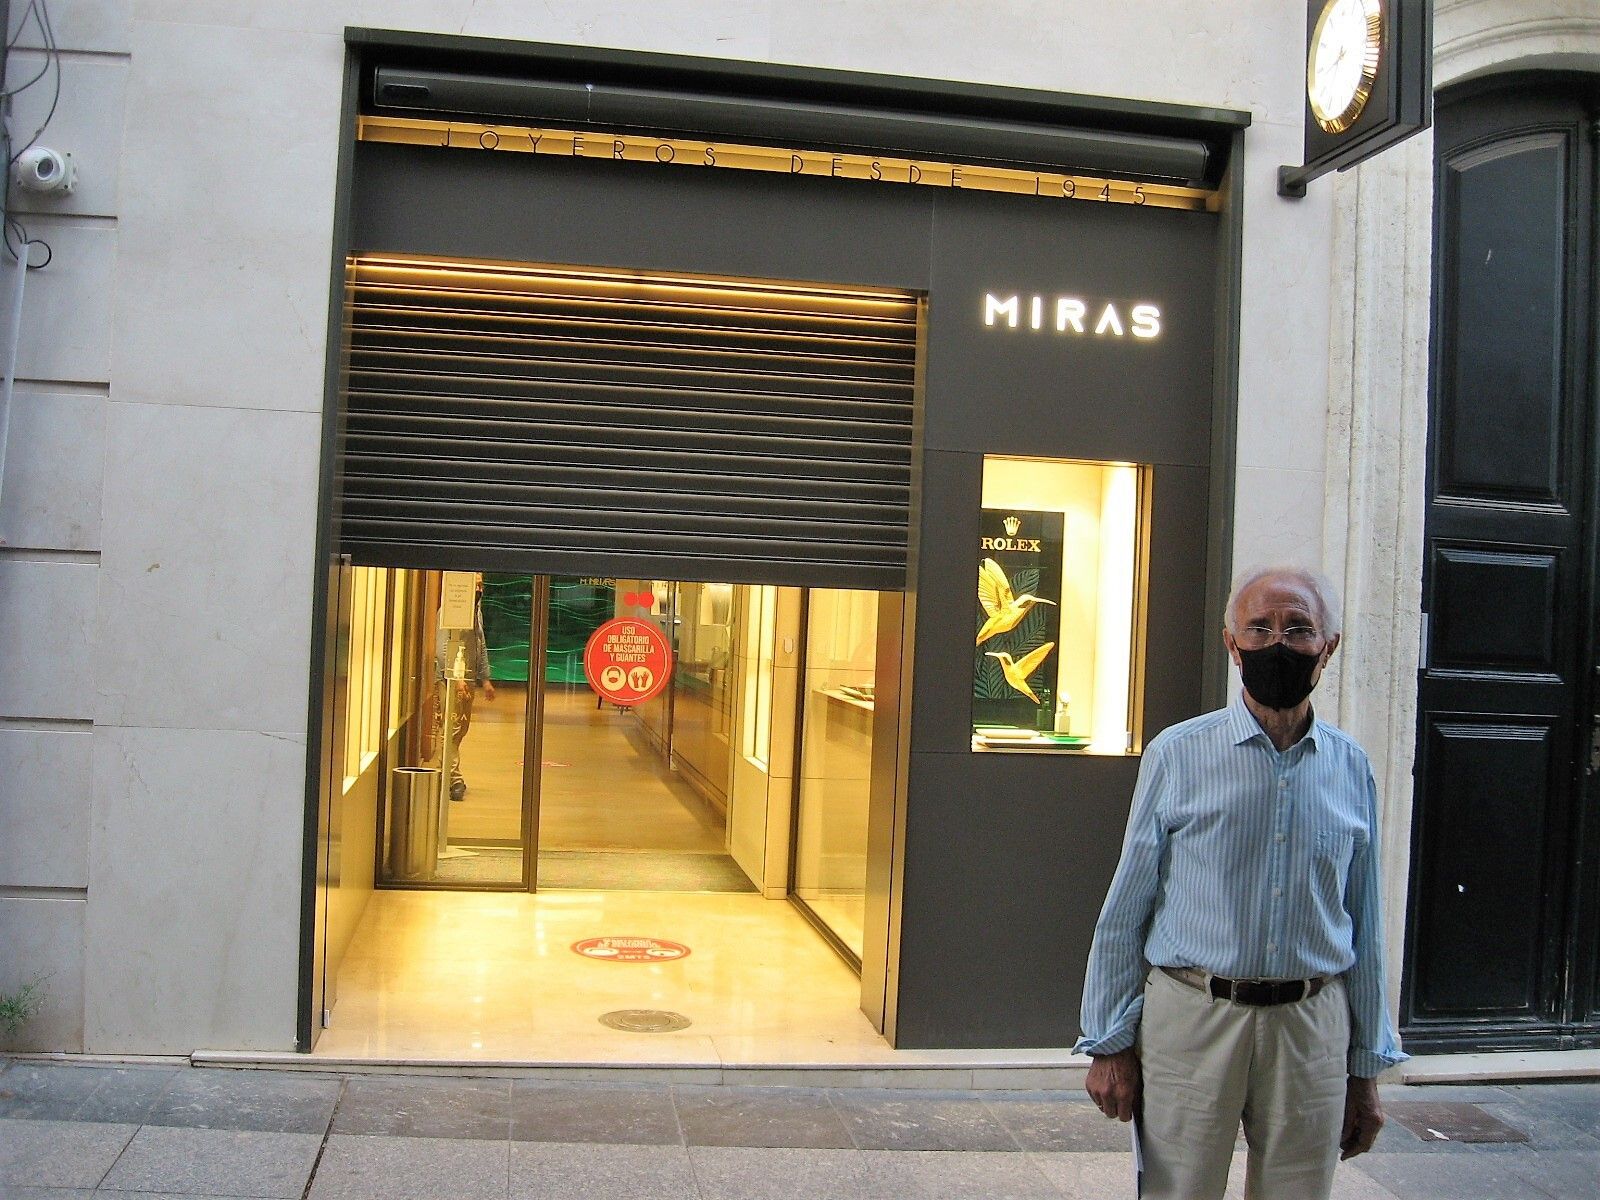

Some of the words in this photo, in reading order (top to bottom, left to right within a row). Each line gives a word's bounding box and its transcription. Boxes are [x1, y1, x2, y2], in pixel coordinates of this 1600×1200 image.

[440, 127, 717, 167] JOYEROS
[789, 154, 963, 189] DESDE
[1034, 176, 1147, 206] 1945
[984, 292, 1161, 338] MIRAS
[980, 537, 1042, 553] ROLEX
[621, 625, 636, 635] USO
[607, 634, 650, 645] OBLIGATORIO
[603, 643, 613, 653] DE
[613, 643, 655, 654] MASCARILLA
[609, 653, 615, 662] Y
[616, 653, 646, 663] GUANTES
